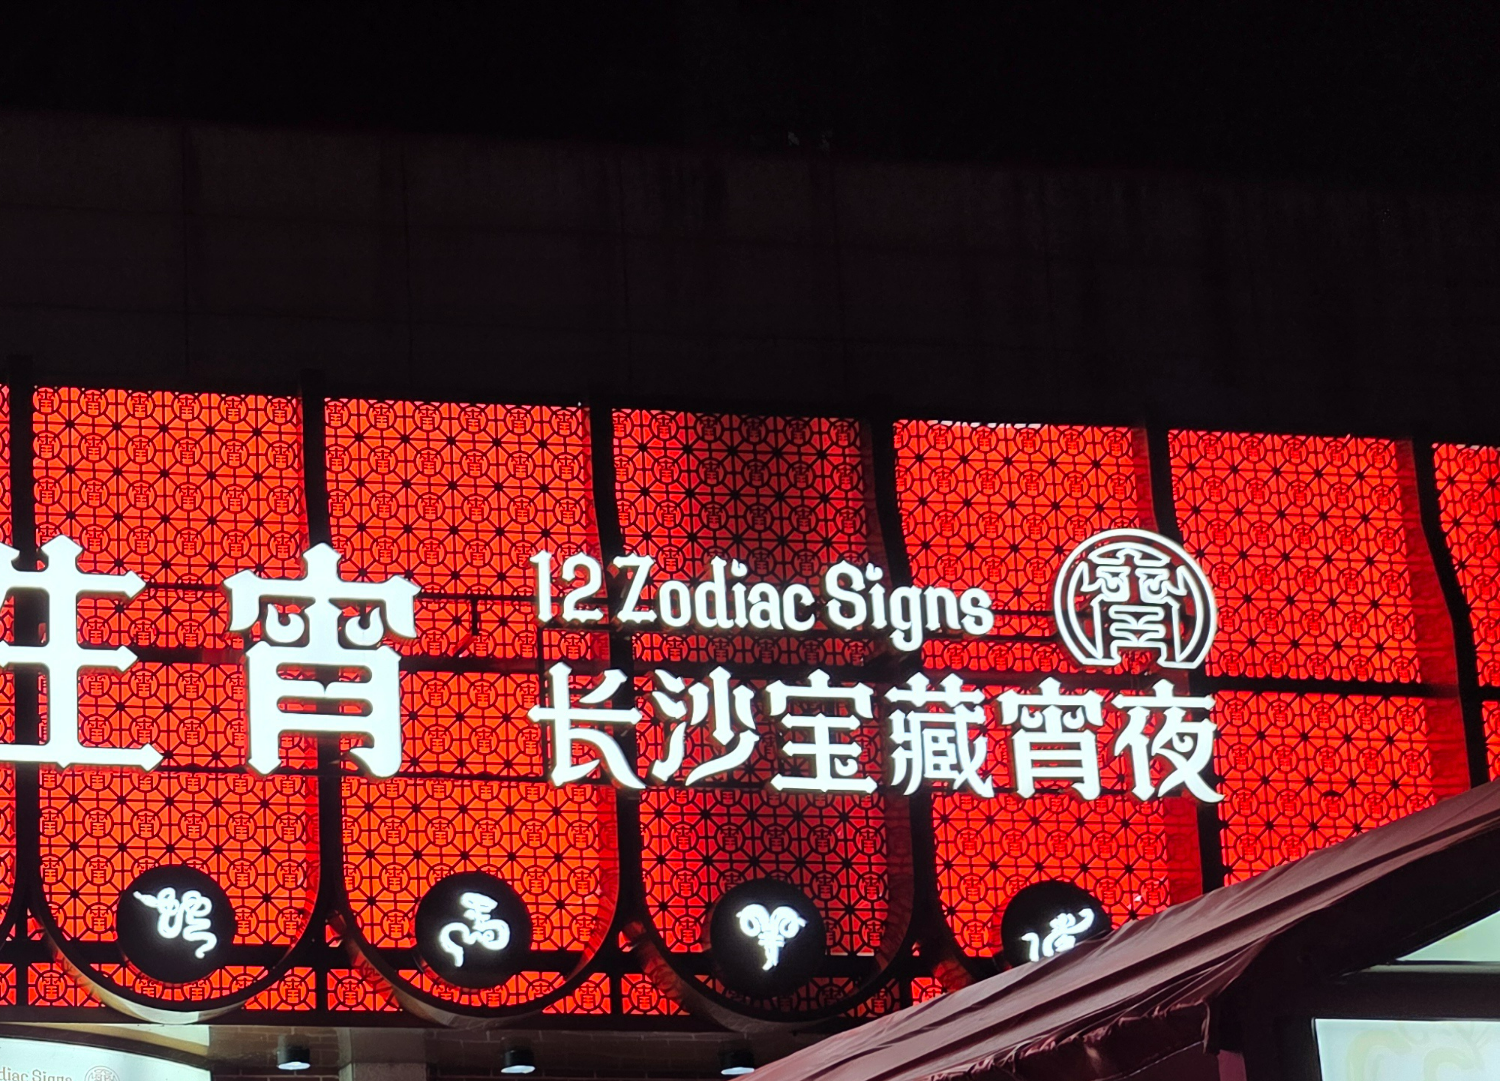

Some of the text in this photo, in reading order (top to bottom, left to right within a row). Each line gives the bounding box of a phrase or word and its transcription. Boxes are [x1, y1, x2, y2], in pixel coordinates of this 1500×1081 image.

[529, 550, 995, 652] 12 Zodiac Signs
[527, 661, 1226, 803] 长沙宝藏宵夜
